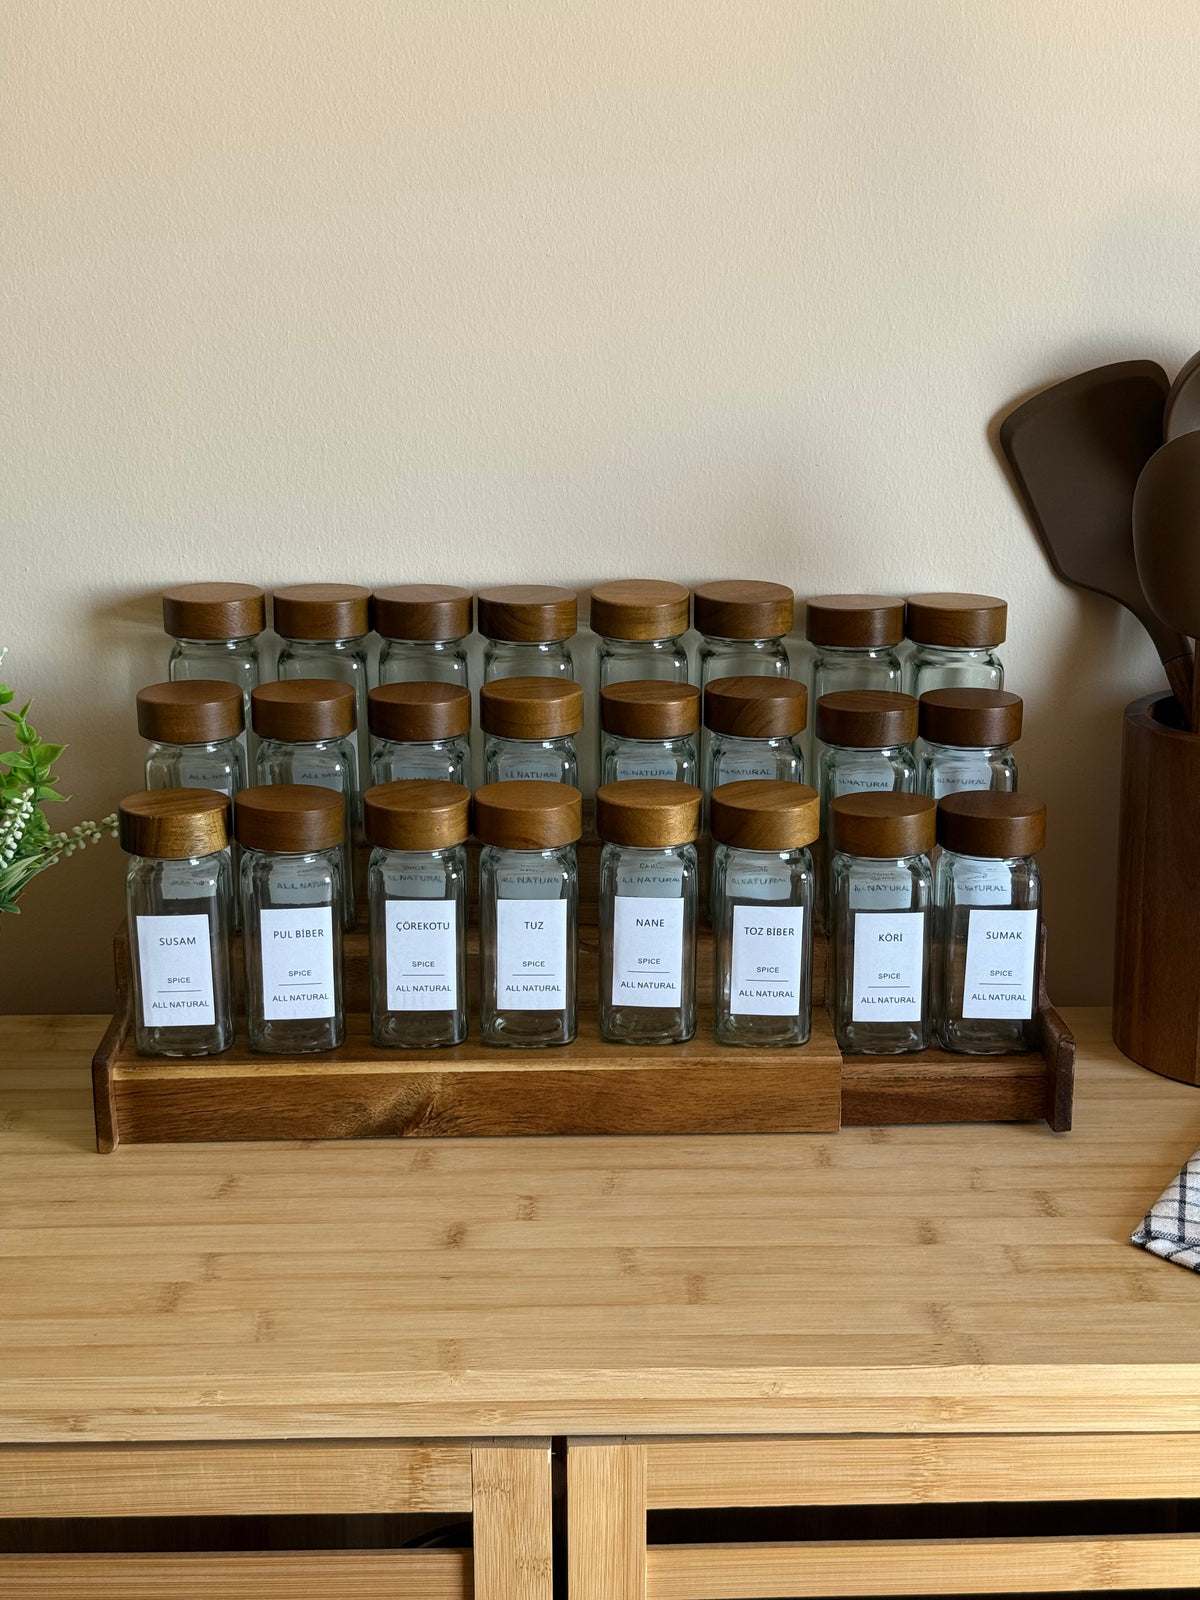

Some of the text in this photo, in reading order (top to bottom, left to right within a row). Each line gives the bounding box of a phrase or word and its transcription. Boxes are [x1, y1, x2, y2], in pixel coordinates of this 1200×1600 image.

[396, 920, 450, 931] ÇÖREKOTU
[524, 921, 544, 930] TUZ
[636, 918, 665, 928] NANE
[273, 930, 293, 939] PUL
[744, 926, 764, 936] TOZ
[986, 931, 1023, 940] SUMAK
[159, 936, 196, 946] SUSAM
[412, 960, 435, 968] SPICE
[522, 960, 546, 968] SPICE
[637, 957, 661, 965] SPICE
[288, 969, 312, 977] SPICE
[756, 966, 780, 974] SPICE
[989, 969, 1013, 977] SPICE
[167, 976, 191, 984] SPICE
[878, 972, 901, 980] SPICE
[395, 984, 452, 992] ALL NATURAL
[505, 984, 561, 992] ALL NATURAL
[620, 981, 676, 990] ALL NATURAL
[272, 993, 329, 1002] ALL NATURAL
[738, 989, 795, 998] ALL NATURAL
[971, 993, 1027, 1001] ALL NATURAL
[861, 996, 916, 1004] ALL NATURAL
[152, 1000, 210, 1009] ALL NATURAL
